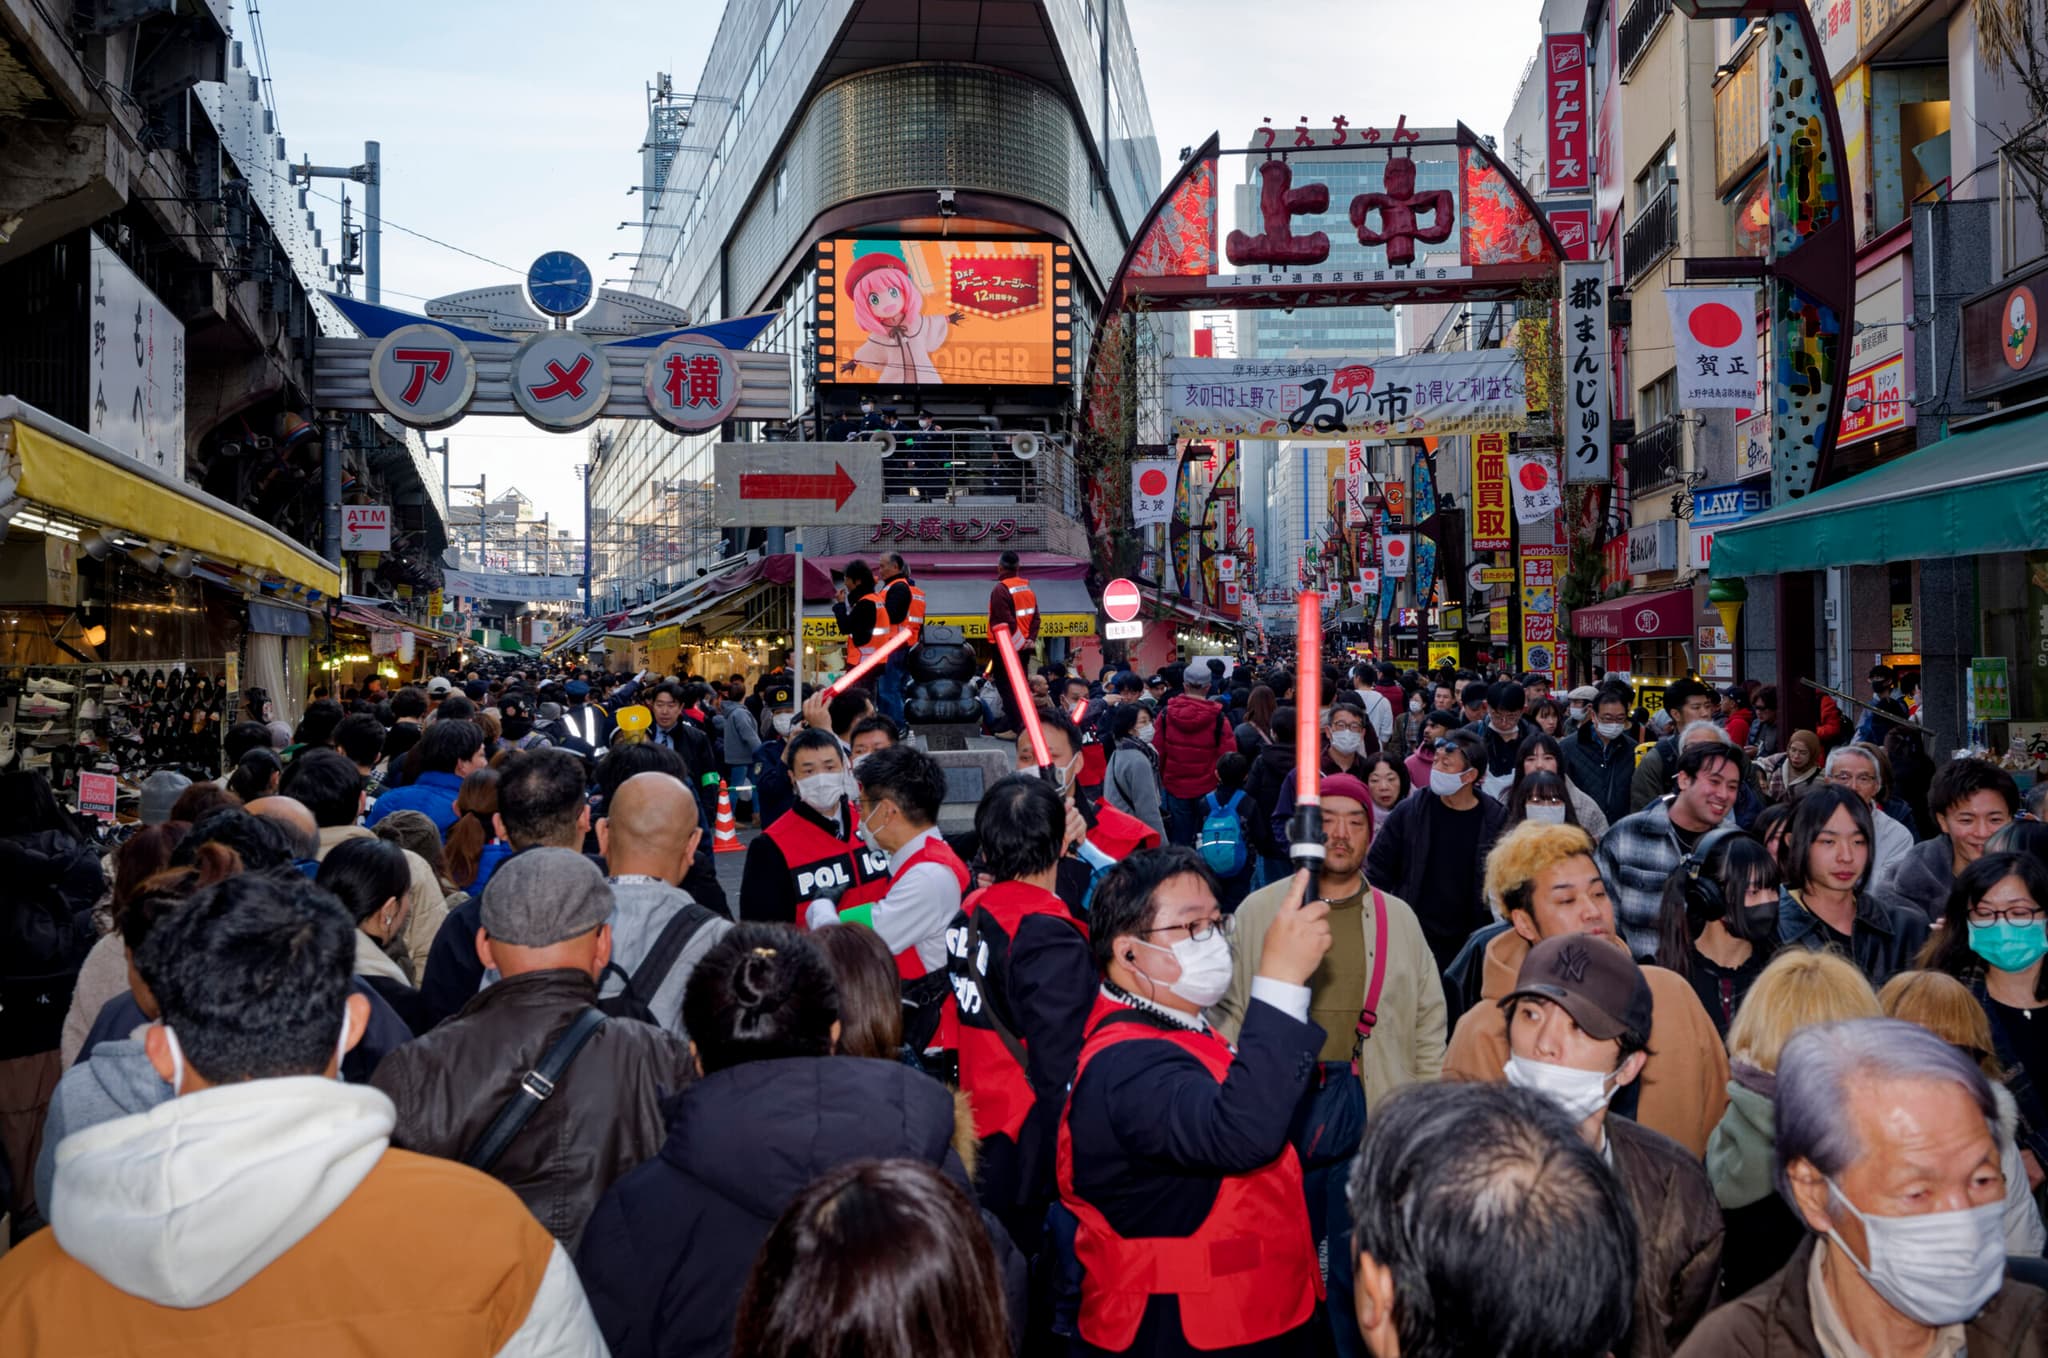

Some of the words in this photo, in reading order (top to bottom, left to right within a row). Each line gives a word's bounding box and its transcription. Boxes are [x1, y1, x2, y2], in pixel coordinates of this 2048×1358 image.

[1258, 114, 1420, 148] うえちゅん
[1555, 80, 1580, 178] アドアーズ
[1226, 157, 1454, 266] 上中
[1231, 269, 1447, 286] 上野中通商店街振興組合
[1232, 364, 1328, 377] 摩利支天御縁日
[1569, 278, 1603, 464] 都まんじゅう
[1696, 354, 1749, 377] 賀正
[393, 347, 723, 410] アメ横
[1186, 384, 1278, 410] 亥の日は上野で
[1477, 433, 1505, 536] 高価買取
[347, 510, 385, 522] ATM
[871, 517, 1039, 542] アメ横センター
[1474, 539, 1509, 548] おたからや
[1526, 560, 1538, 574] 金
[1526, 615, 1553, 627] ブランド
[1526, 629, 1553, 640] バッグ
[798, 862, 850, 896] POL
